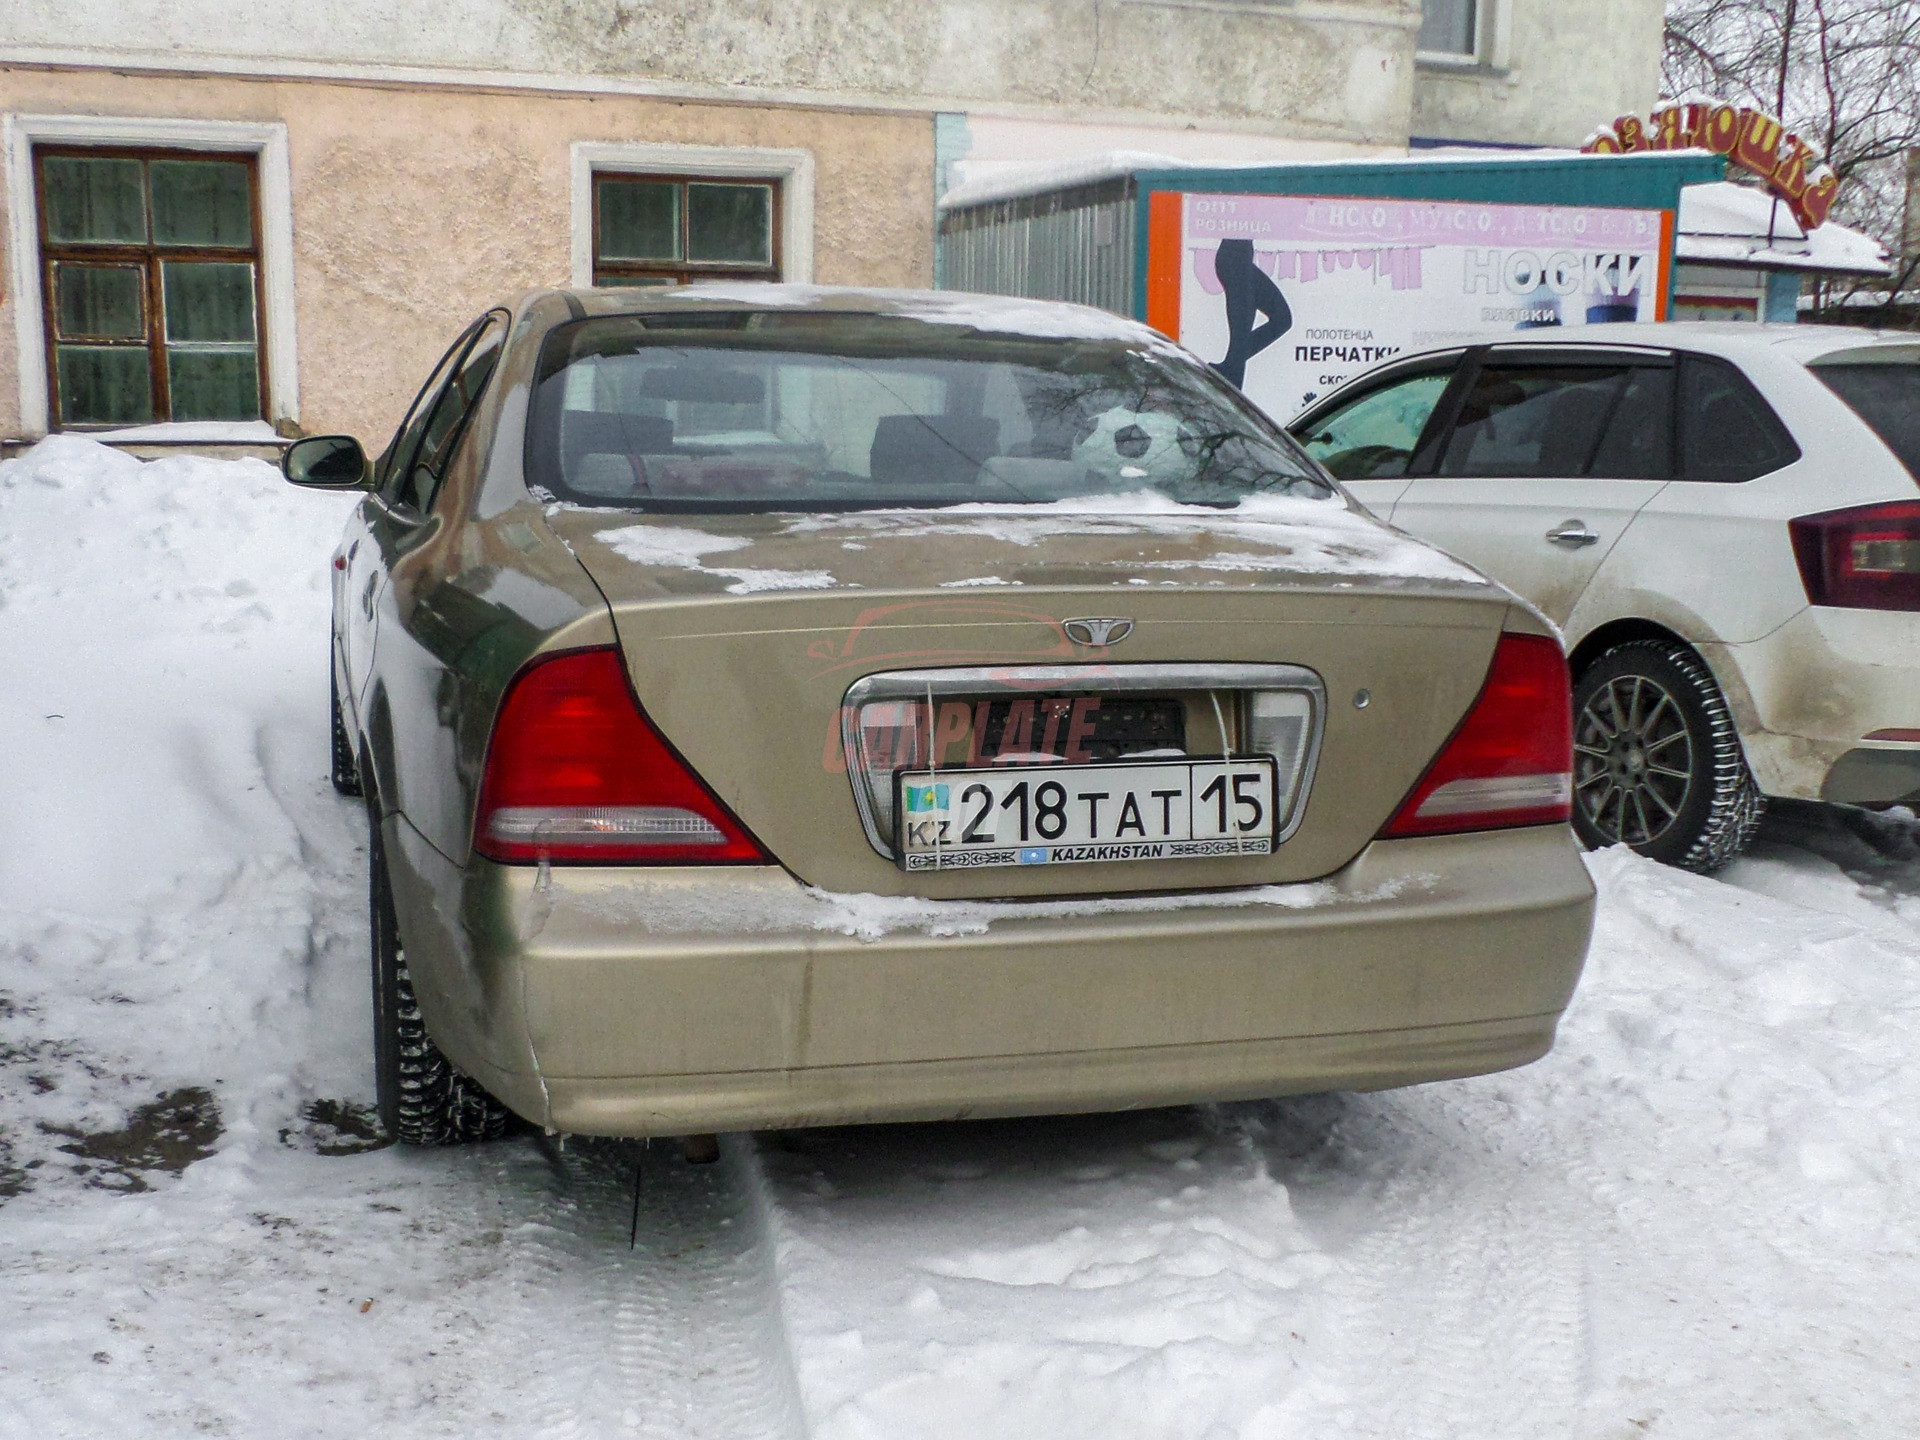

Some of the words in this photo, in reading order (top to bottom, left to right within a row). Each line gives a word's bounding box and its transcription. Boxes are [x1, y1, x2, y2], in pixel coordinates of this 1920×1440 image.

[1196, 201, 1239, 214] ОПТ
[1196, 218, 1272, 233] РОЗНИЦА
[1463, 250, 1652, 297] НОСКИ
[1306, 329, 1374, 341] ПОЛОТЕНЦА
[1199, 773, 1263, 835] 15
[907, 820, 952, 846] KZ
[1051, 844, 1163, 862] KAZAKHSTAN
